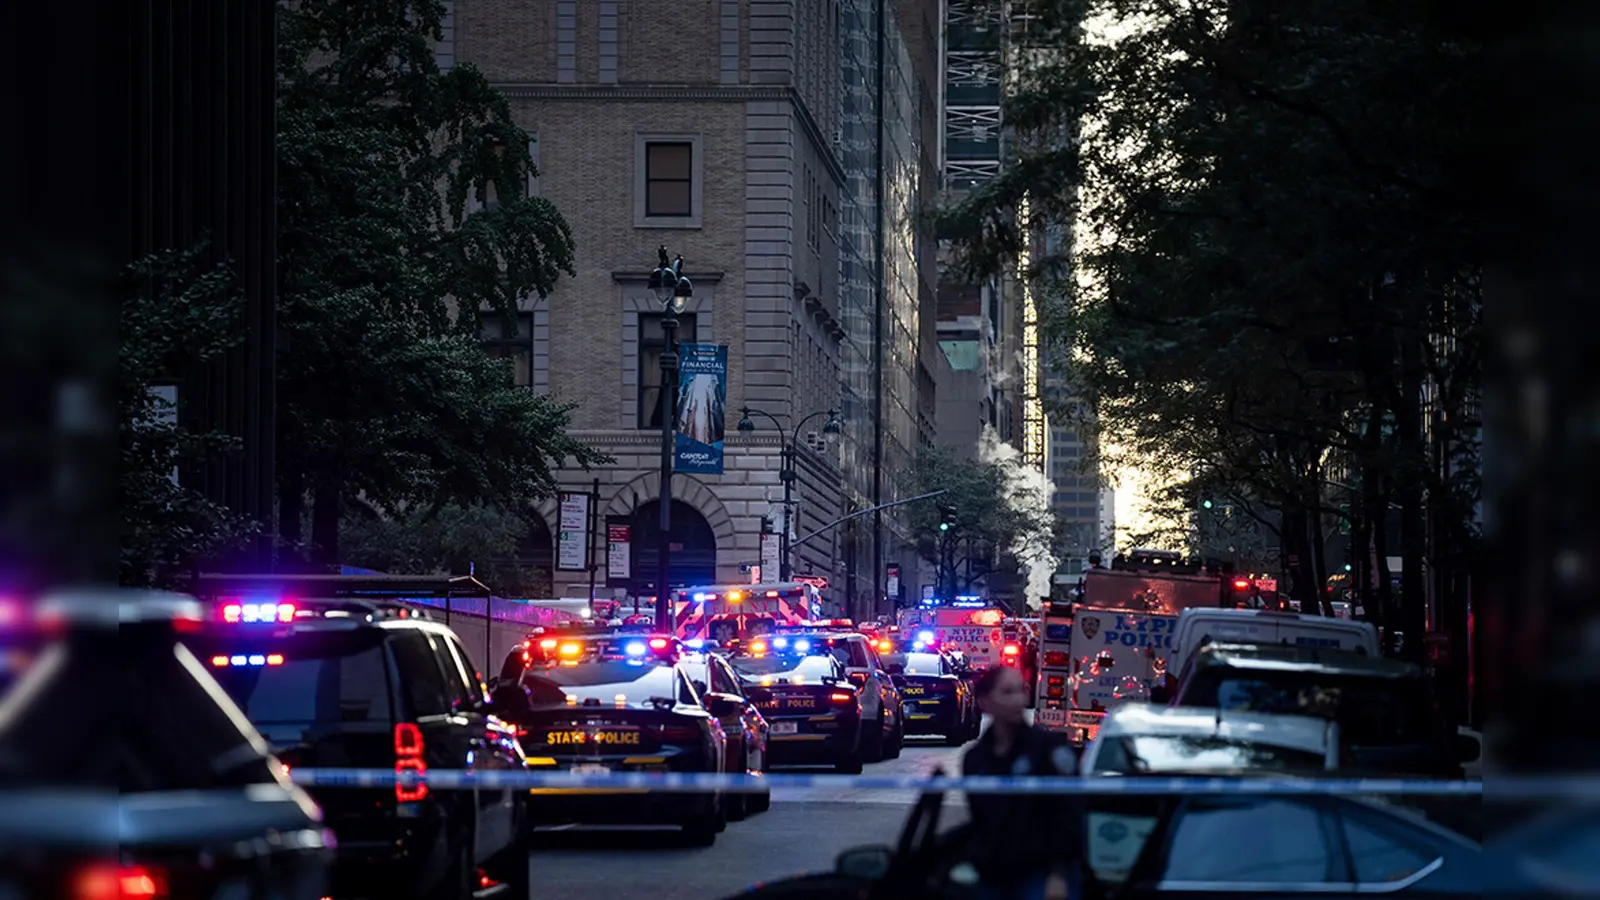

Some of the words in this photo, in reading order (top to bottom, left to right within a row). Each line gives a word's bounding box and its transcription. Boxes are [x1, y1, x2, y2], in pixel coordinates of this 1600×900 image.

[681, 361, 724, 369] FINANCIAL
[787, 699, 816, 708] POLICE
[547, 731, 586, 744] STATE
[597, 732, 640, 744] POLICE
